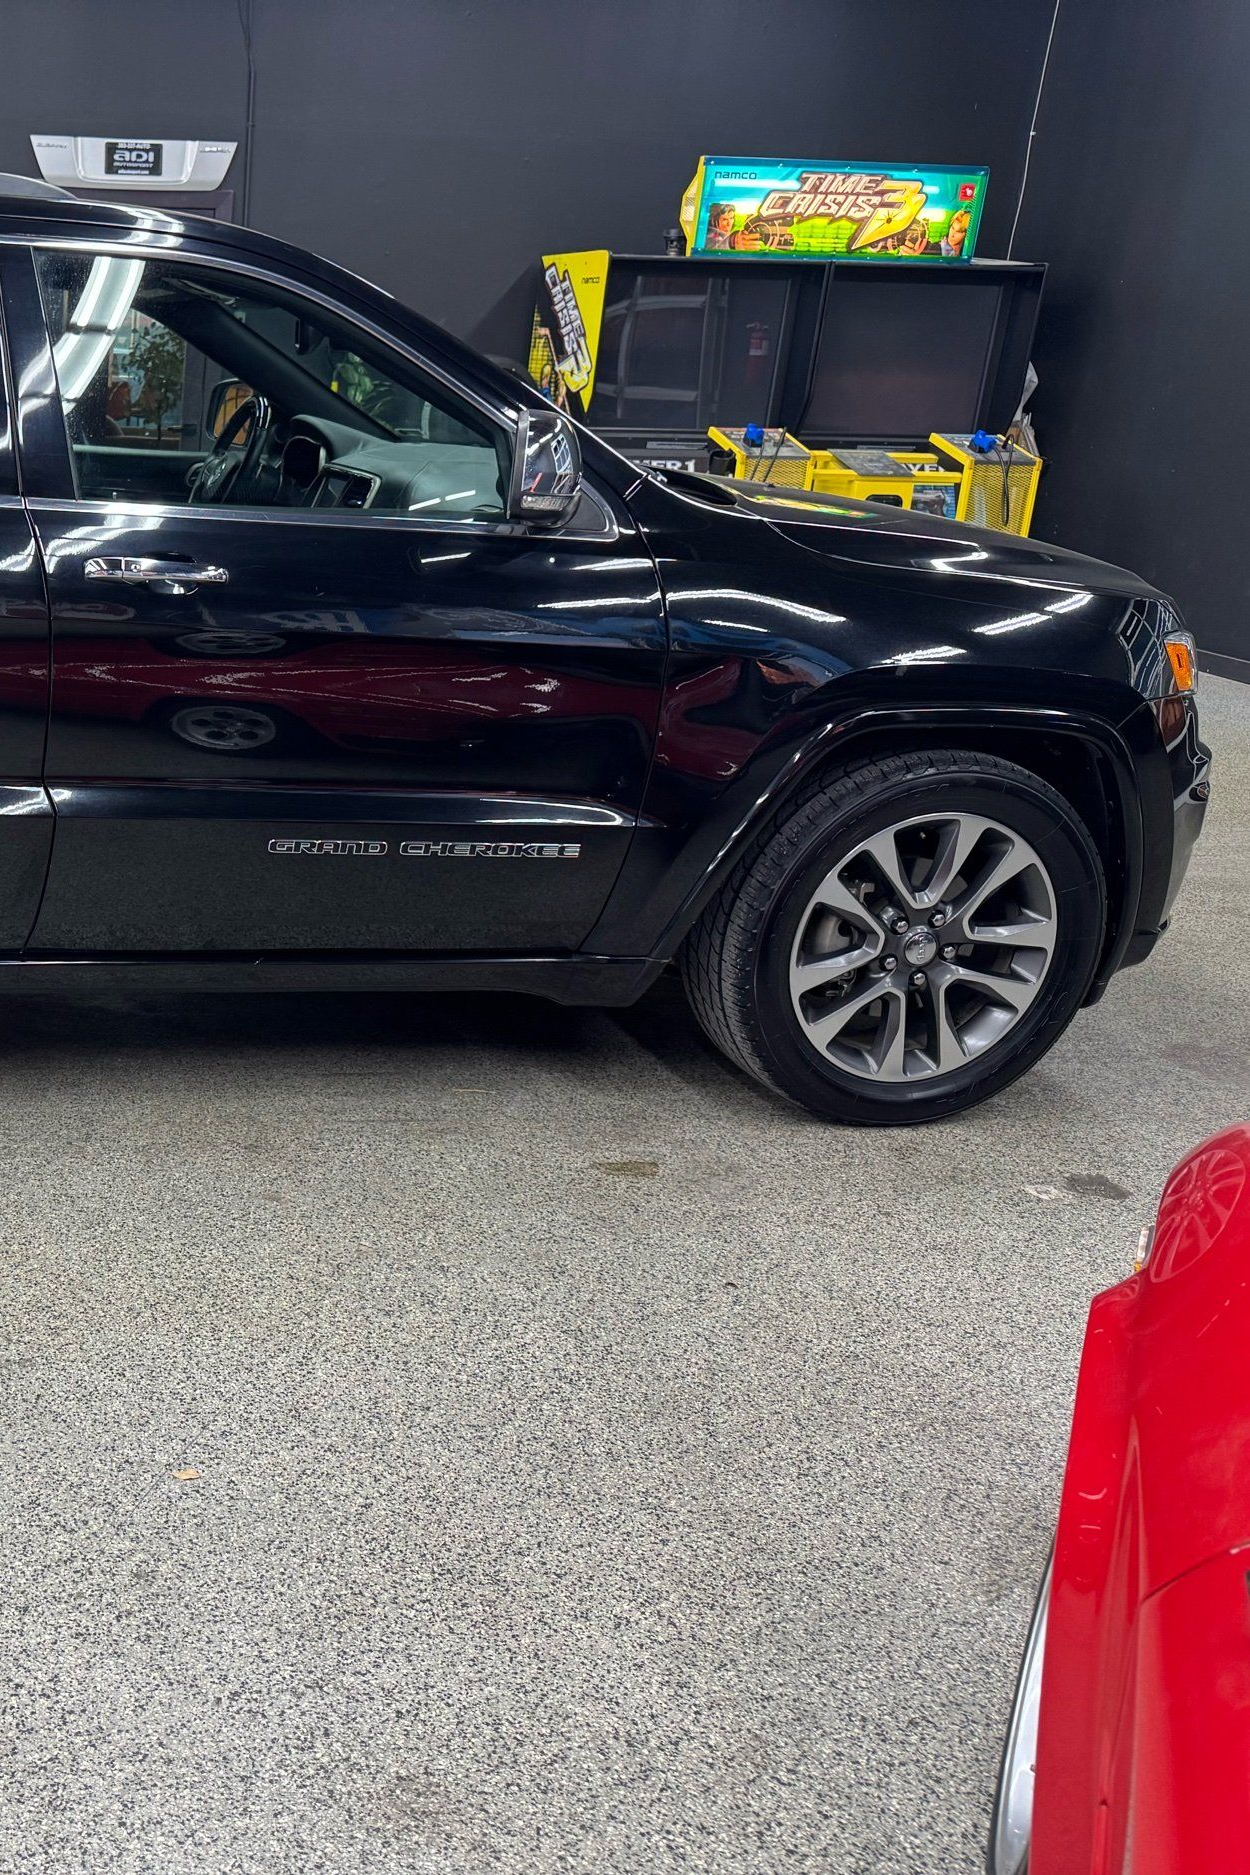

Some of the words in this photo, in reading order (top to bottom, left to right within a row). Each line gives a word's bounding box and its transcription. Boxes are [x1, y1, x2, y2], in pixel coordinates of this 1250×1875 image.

[714, 170, 758, 181] namco
[801, 172, 883, 195] TIME
[759, 190, 880, 217] CRISIS
[852, 180, 928, 250] 3
[268, 839, 388, 855] GRAND
[400, 841, 581, 858] CHEROKEE
